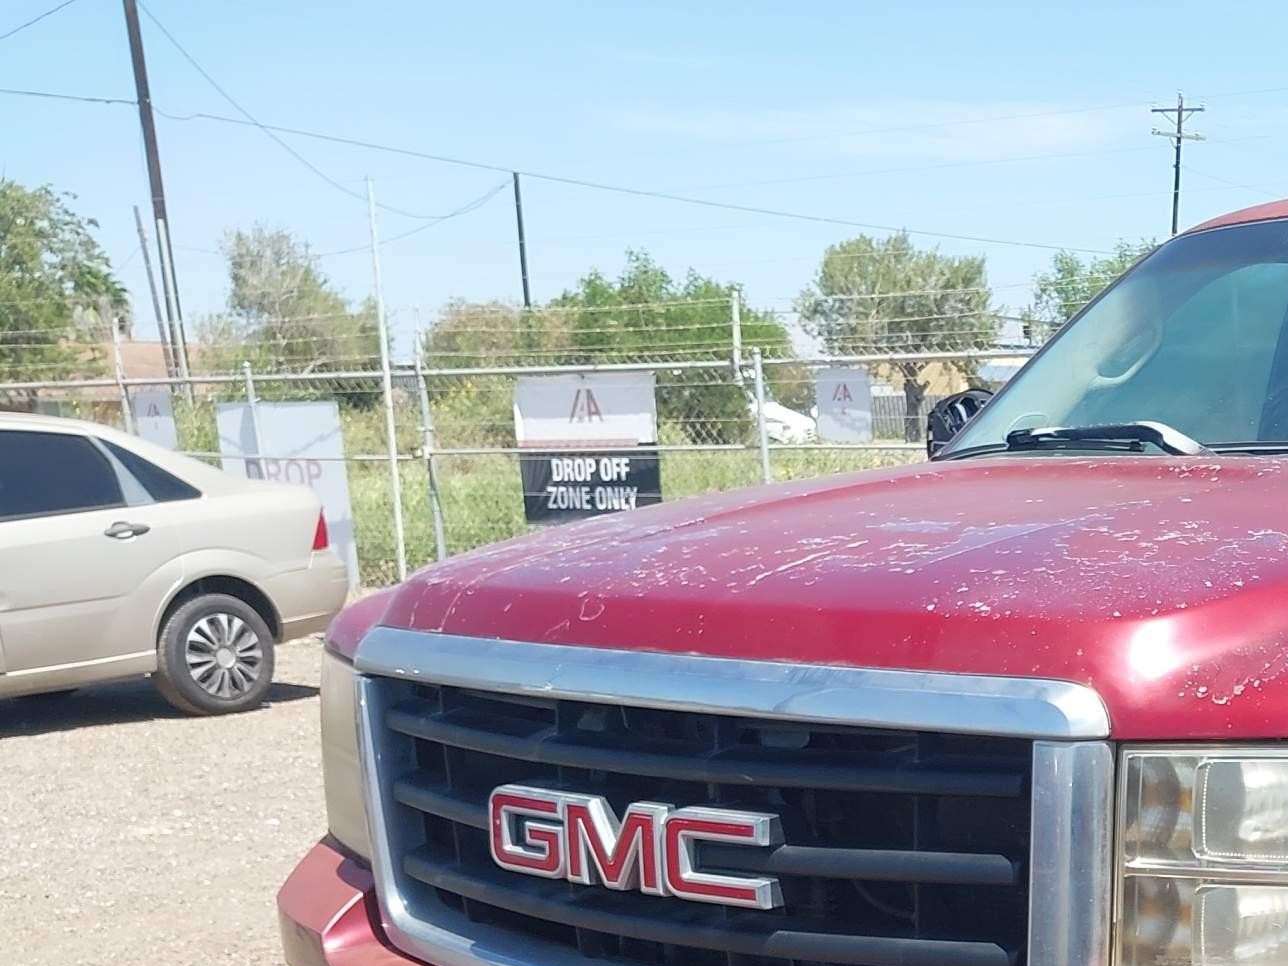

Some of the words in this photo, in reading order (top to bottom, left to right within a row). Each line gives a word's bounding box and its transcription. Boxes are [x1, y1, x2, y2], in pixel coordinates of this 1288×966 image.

[551, 459, 596, 482] DROP
[600, 458, 630, 481] OFF
[547, 486, 592, 510] ZONE
[595, 486, 638, 510] ONLY
[489, 784, 785, 910] GMC
